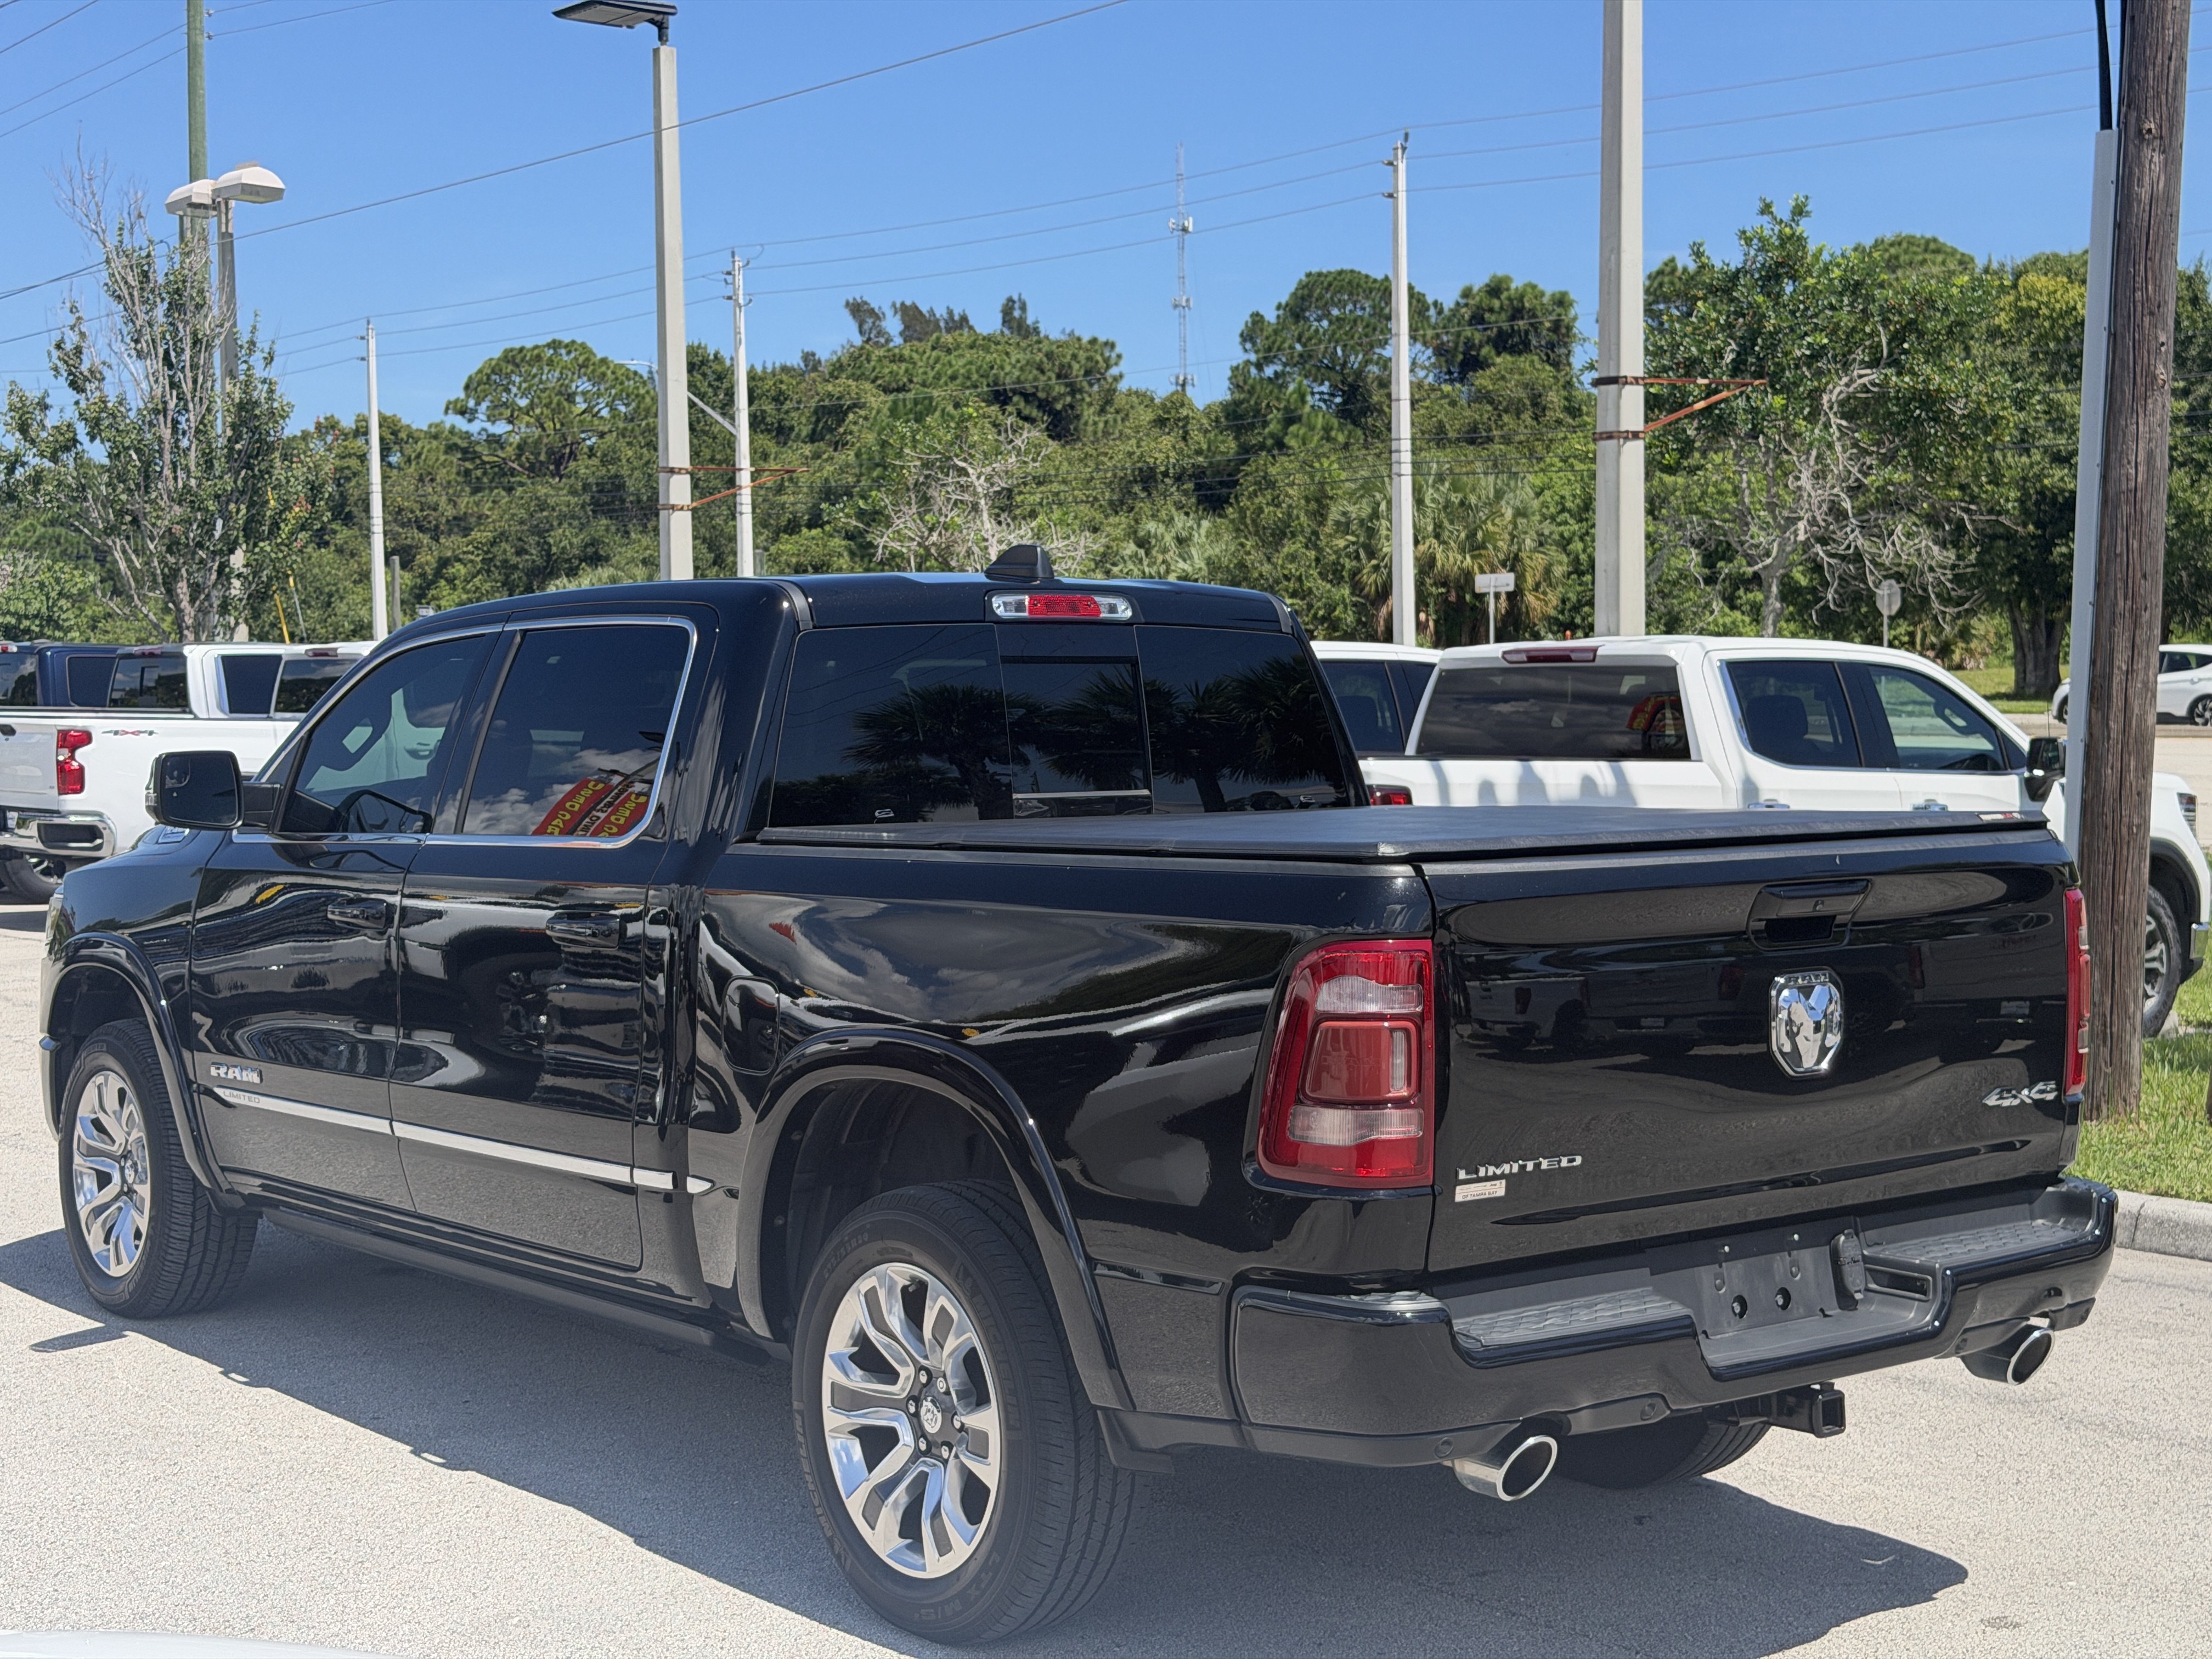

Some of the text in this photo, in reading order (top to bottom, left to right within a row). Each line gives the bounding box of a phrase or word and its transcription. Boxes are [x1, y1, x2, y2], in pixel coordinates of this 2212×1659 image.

[1787, 973, 1830, 985] RAM
[210, 1062, 261, 1084] RAM
[223, 1091, 261, 1104] LIMITED
[1457, 1155, 1582, 1180] LIMITED
[972, 1294, 1022, 1430] MICHELIN
[794, 1411, 833, 1537] MICHELIN
